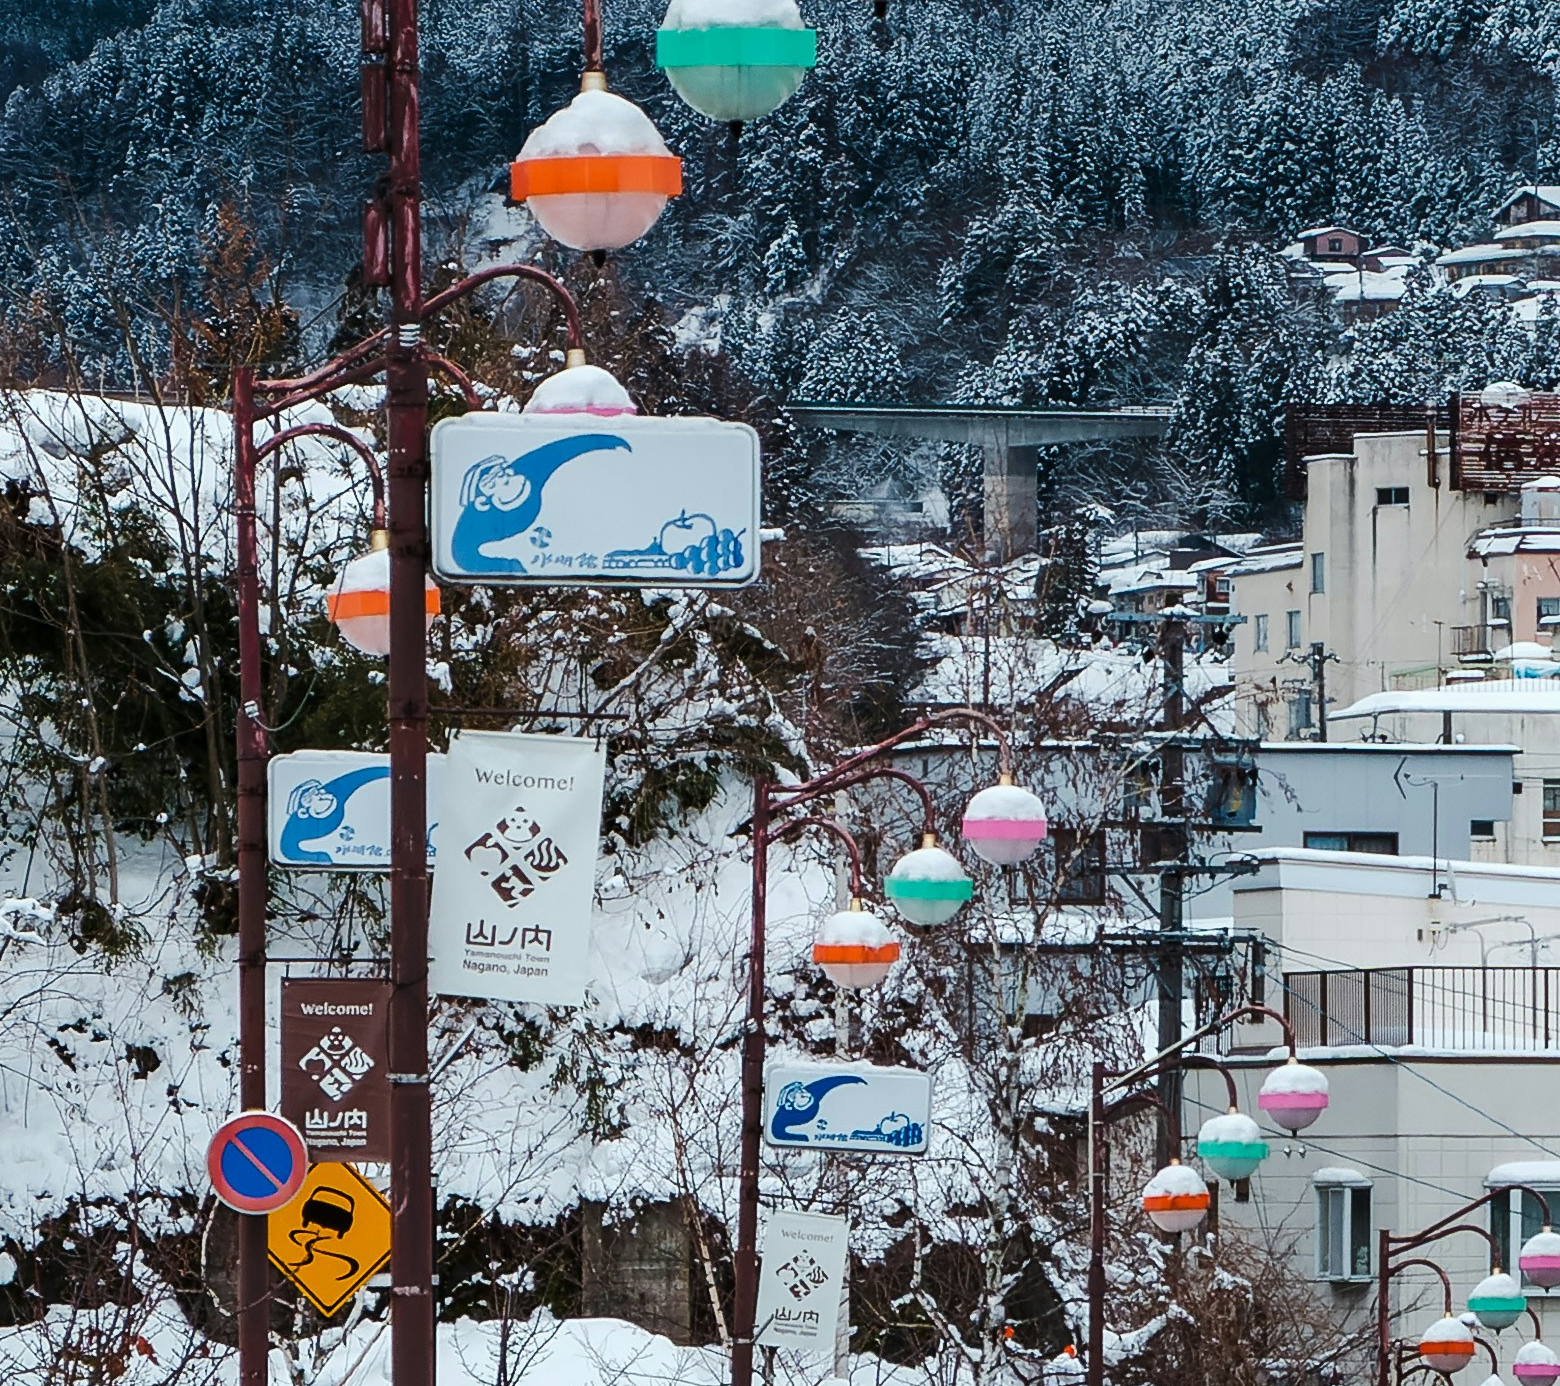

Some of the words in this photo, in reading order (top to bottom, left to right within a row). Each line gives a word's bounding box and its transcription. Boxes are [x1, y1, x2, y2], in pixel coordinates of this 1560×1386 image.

[474, 767, 576, 791] Welcome!
[465, 919, 552, 951] 山ノ内
[462, 959, 510, 974] Nagano,
[513, 963, 549, 976] Japan
[300, 1001, 373, 1016] Welcome!
[305, 1108, 368, 1128] 山ノ内
[781, 1228, 834, 1243] Welcome!
[774, 1306, 820, 1324] 山ノ内
